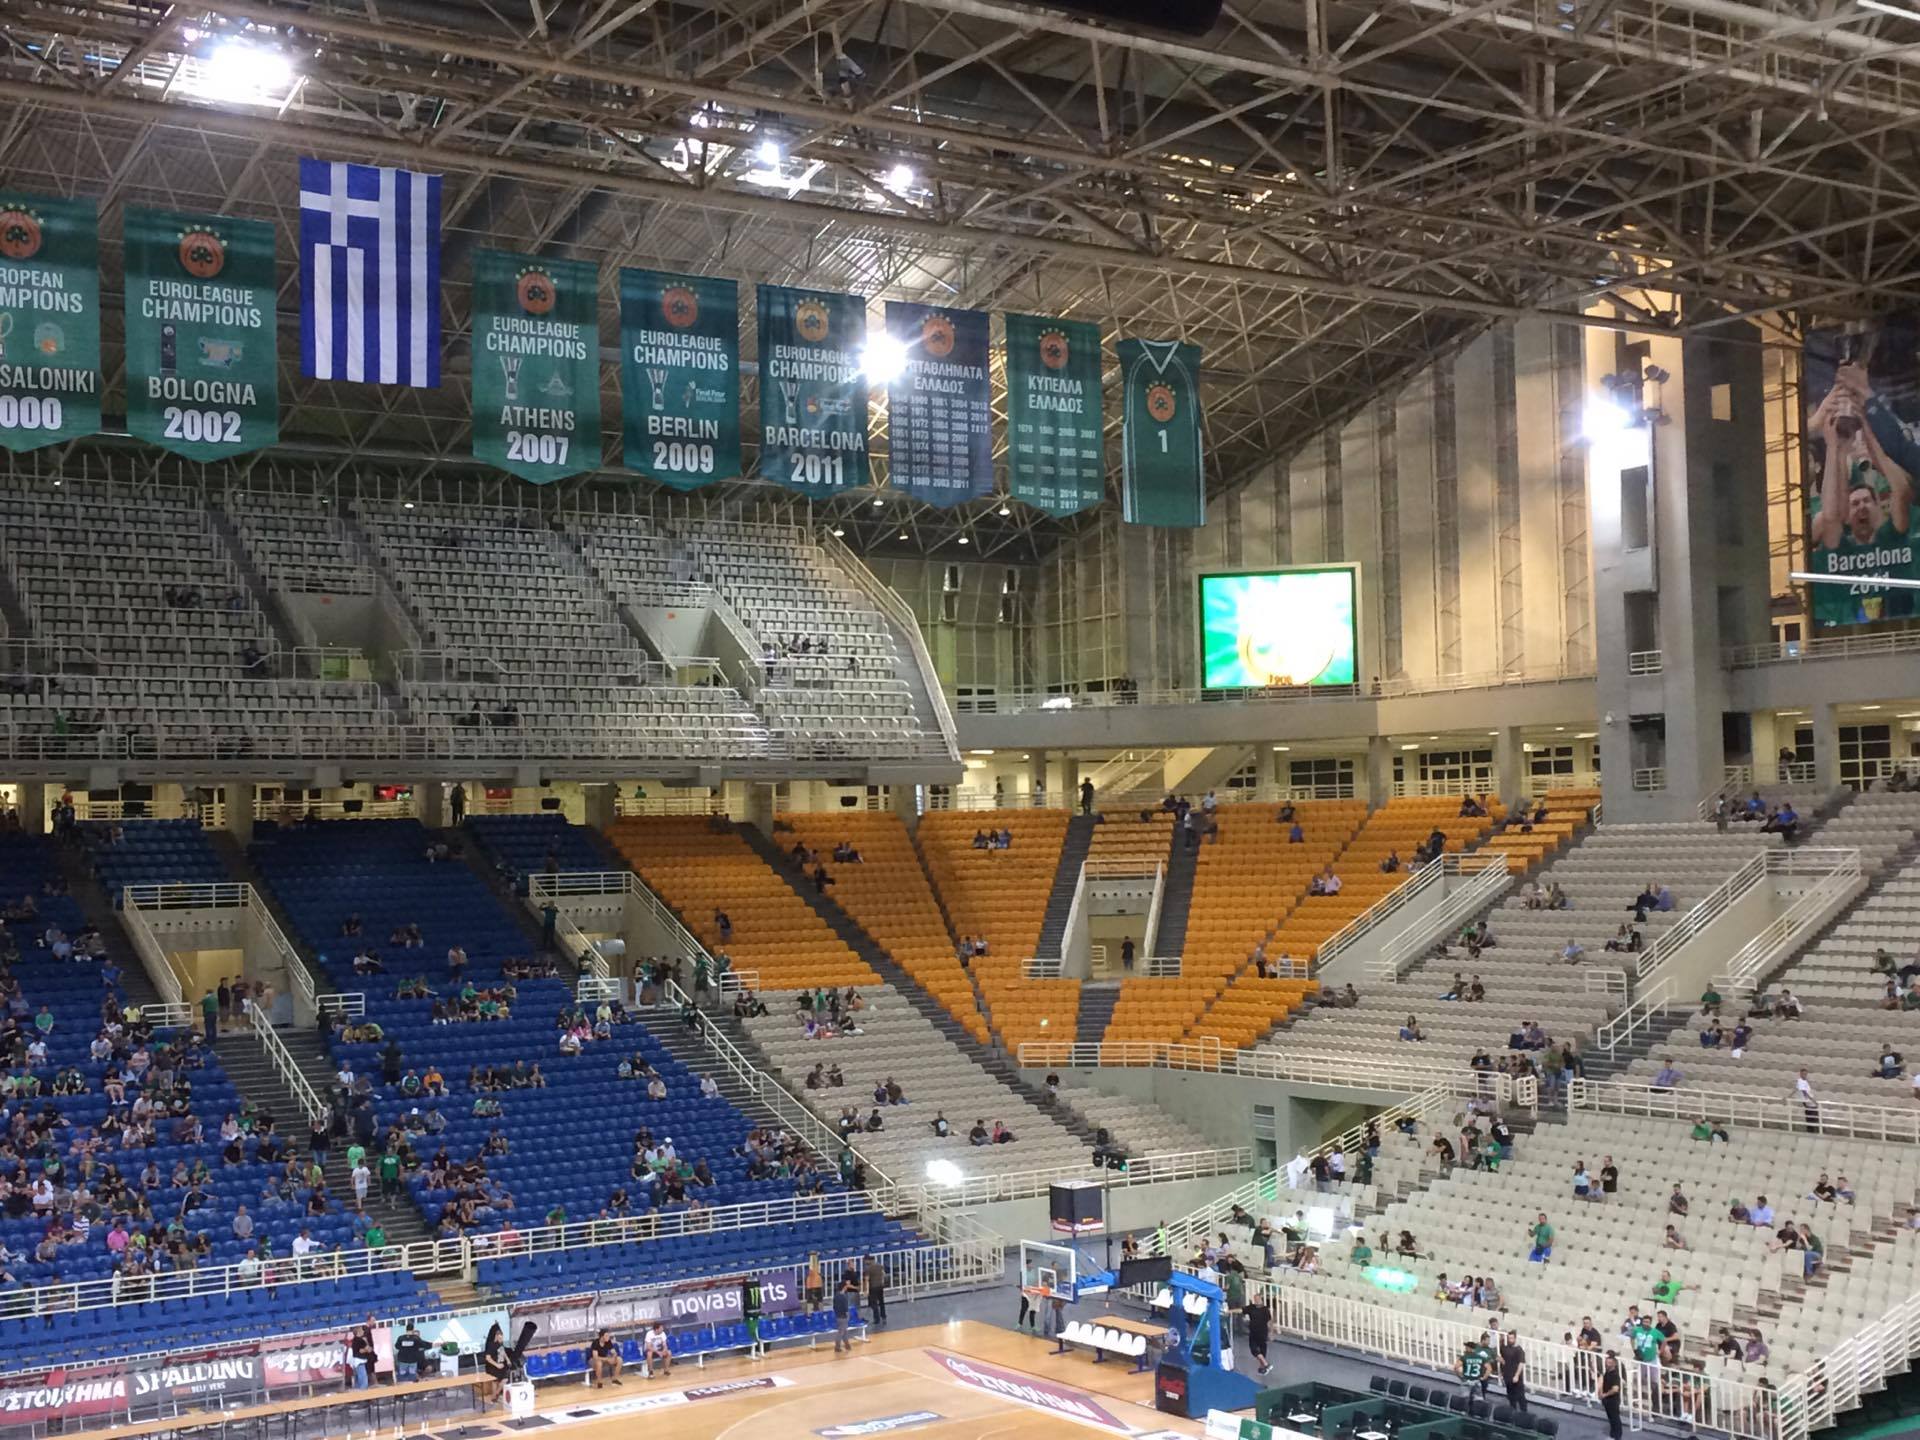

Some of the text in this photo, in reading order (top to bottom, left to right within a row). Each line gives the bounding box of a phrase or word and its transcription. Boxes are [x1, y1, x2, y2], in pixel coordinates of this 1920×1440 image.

[149, 280, 253, 305] EUROLEAGUE
[142, 297, 262, 328] CHAMPIONS
[493, 316, 579, 339] EUROLEAGUE
[486, 332, 587, 360] CHAMPIONS
[640, 330, 722, 352] EUROLEAGUE
[634, 345, 729, 371] CHAMPIONS
[775, 344, 853, 365] EUROLEAGUE
[0, 364, 95, 393] SALONIKI
[769, 360, 858, 384] CHAMPIONS
[148, 376, 257, 405] BOLOGNA
[914, 377, 965, 394] ΕΛΛΑΔΟΣ
[1028, 376, 1083, 395] ΚΥΠΕΛΛΑ
[1028, 394, 1084, 413] ΕΛΛΑΔΟΣ
[164, 406, 241, 442] 2002
[501, 405, 575, 431] ATHENS
[648, 415, 719, 440] BERLIN
[506, 431, 569, 465] 2007
[766, 426, 864, 451] BARCELONA
[1158, 430, 1168, 453] 1
[653, 441, 714, 473] 2009
[791, 453, 843, 485] 2011
[1827, 546, 1913, 573] Barcelona
[136, 1358, 254, 1396] SPALDING
[1464, 1363, 1481, 1377] 13
